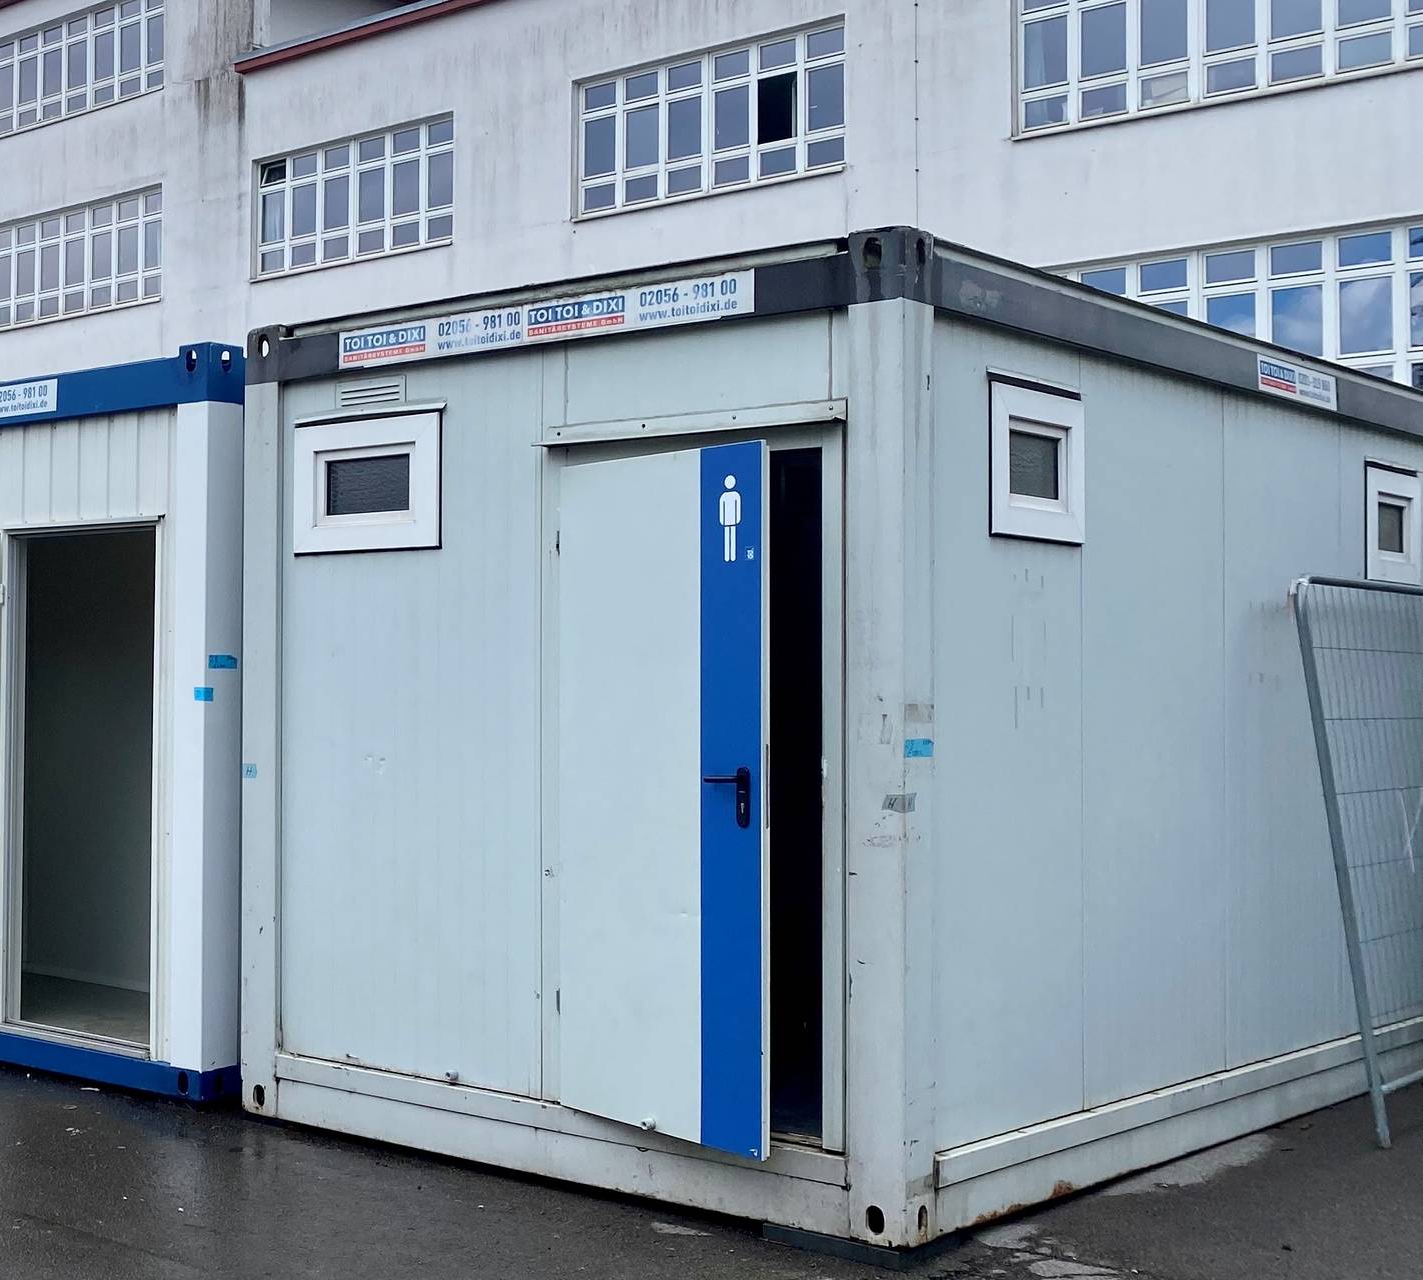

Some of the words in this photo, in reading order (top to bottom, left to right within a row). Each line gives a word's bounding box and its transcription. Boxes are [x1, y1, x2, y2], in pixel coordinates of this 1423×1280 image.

[640, 287, 679, 307] 02056
[693, 281, 715, 300] 981
[720, 278, 737, 296] 00
[483, 314, 502, 331] 981
[507, 311, 520, 327] 00
[529, 309, 551, 323] TOI
[555, 304, 578, 319] TOI
[581, 304, 590, 315] &
[593, 298, 623, 314] DIXI
[600, 316, 624, 326] GmbH
[640, 299, 737, 322] www.toitoidixi.de
[345, 336, 364, 351] TOI
[367, 333, 386, 347] TOI
[389, 333, 397, 344] &
[398, 327, 424, 343] DIXI
[23, 386, 36, 399] 981
[38, 384, 48, 397] 00
